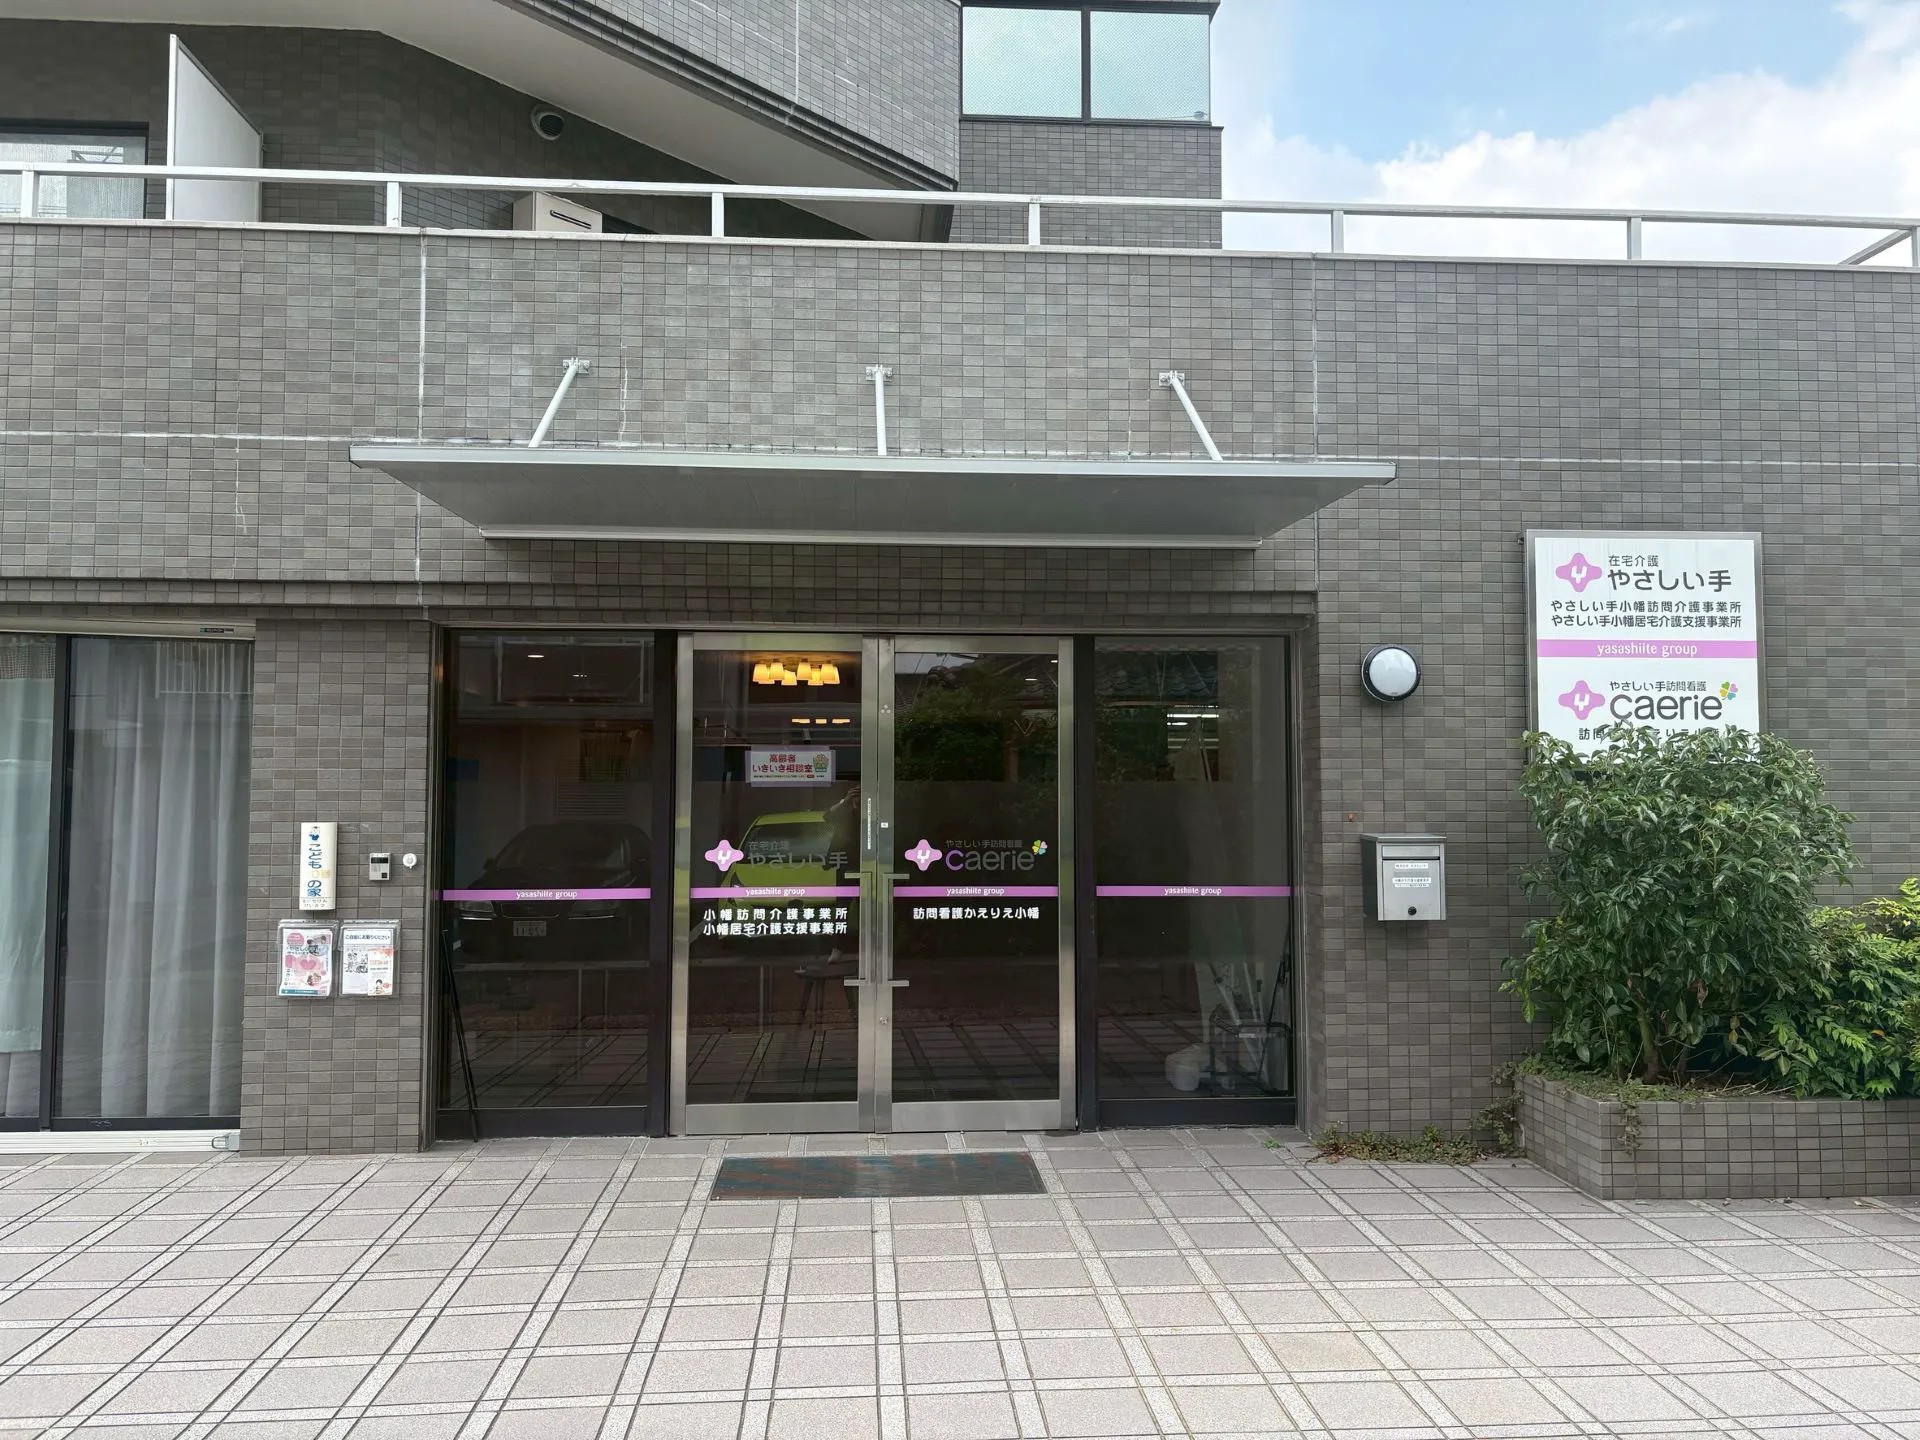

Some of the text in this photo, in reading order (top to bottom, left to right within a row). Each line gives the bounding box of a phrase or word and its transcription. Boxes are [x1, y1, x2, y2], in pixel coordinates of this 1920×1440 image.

[1608, 555, 1659, 567] 在宅介護
[1607, 569, 1732, 593] やさしい手
[1550, 600, 1742, 613] やさしい手小幡訪問介護事業所
[1551, 615, 1742, 628] やさしい手小幡居宅介護支援事業所
[1597, 643, 1698, 657] yasashiite group
[1609, 681, 1707, 692] やさしい手訪問看護
[1609, 695, 1723, 721] caerie
[769, 754, 796, 763] 高齢者
[747, 851, 848, 870] やさしい手
[945, 849, 1035, 871] caerie
[516, 890, 578, 899] yasashiite group
[745, 888, 806, 897] yasashiite group
[946, 887, 1005, 896] yasashiite group
[1164, 886, 1222, 895] yasashiite group
[703, 907, 848, 921] 小幡訪問介護事業所
[912, 907, 1041, 920] 訪問看護かえりえ小幡
[703, 922, 848, 936] 小幡居宅介護支援事業所
